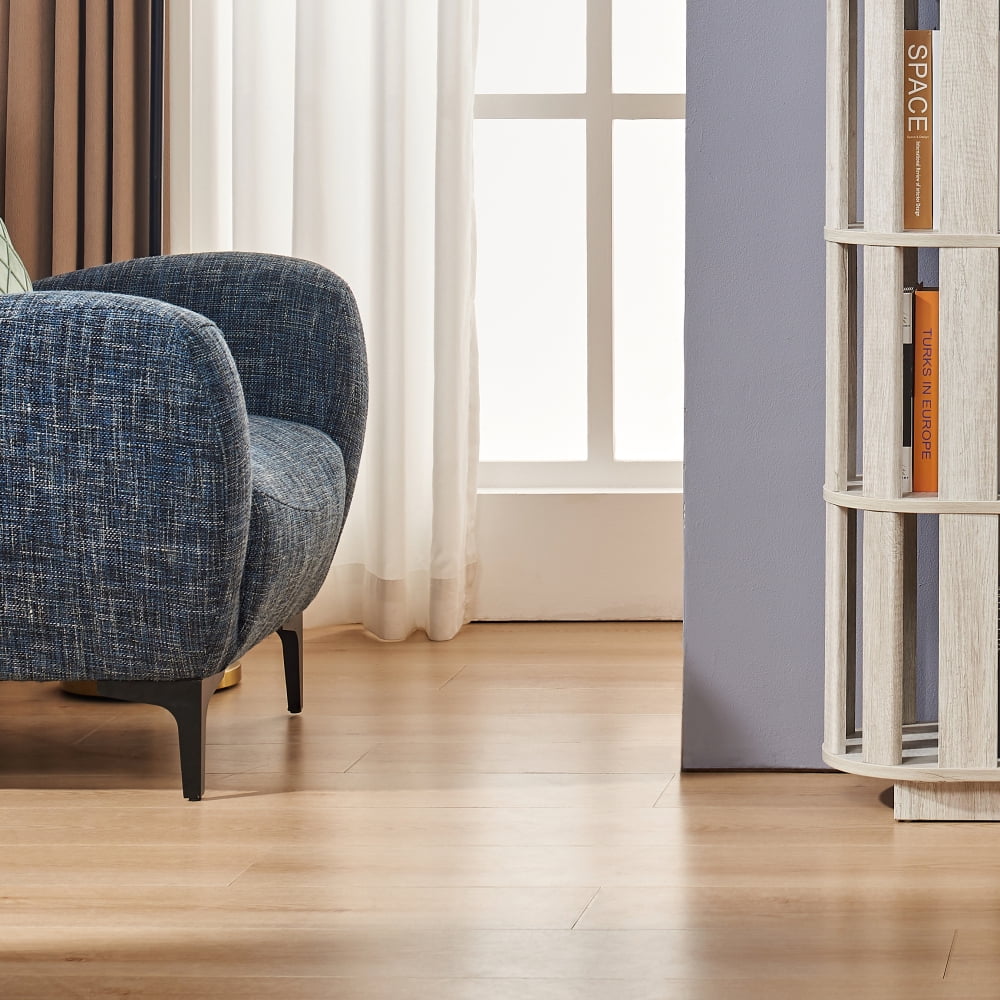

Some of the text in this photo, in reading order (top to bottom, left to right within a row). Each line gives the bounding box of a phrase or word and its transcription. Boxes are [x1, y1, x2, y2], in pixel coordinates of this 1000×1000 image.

[908, 44, 928, 132] SPACE
[921, 327, 933, 461] TURKS IN EUROPE
